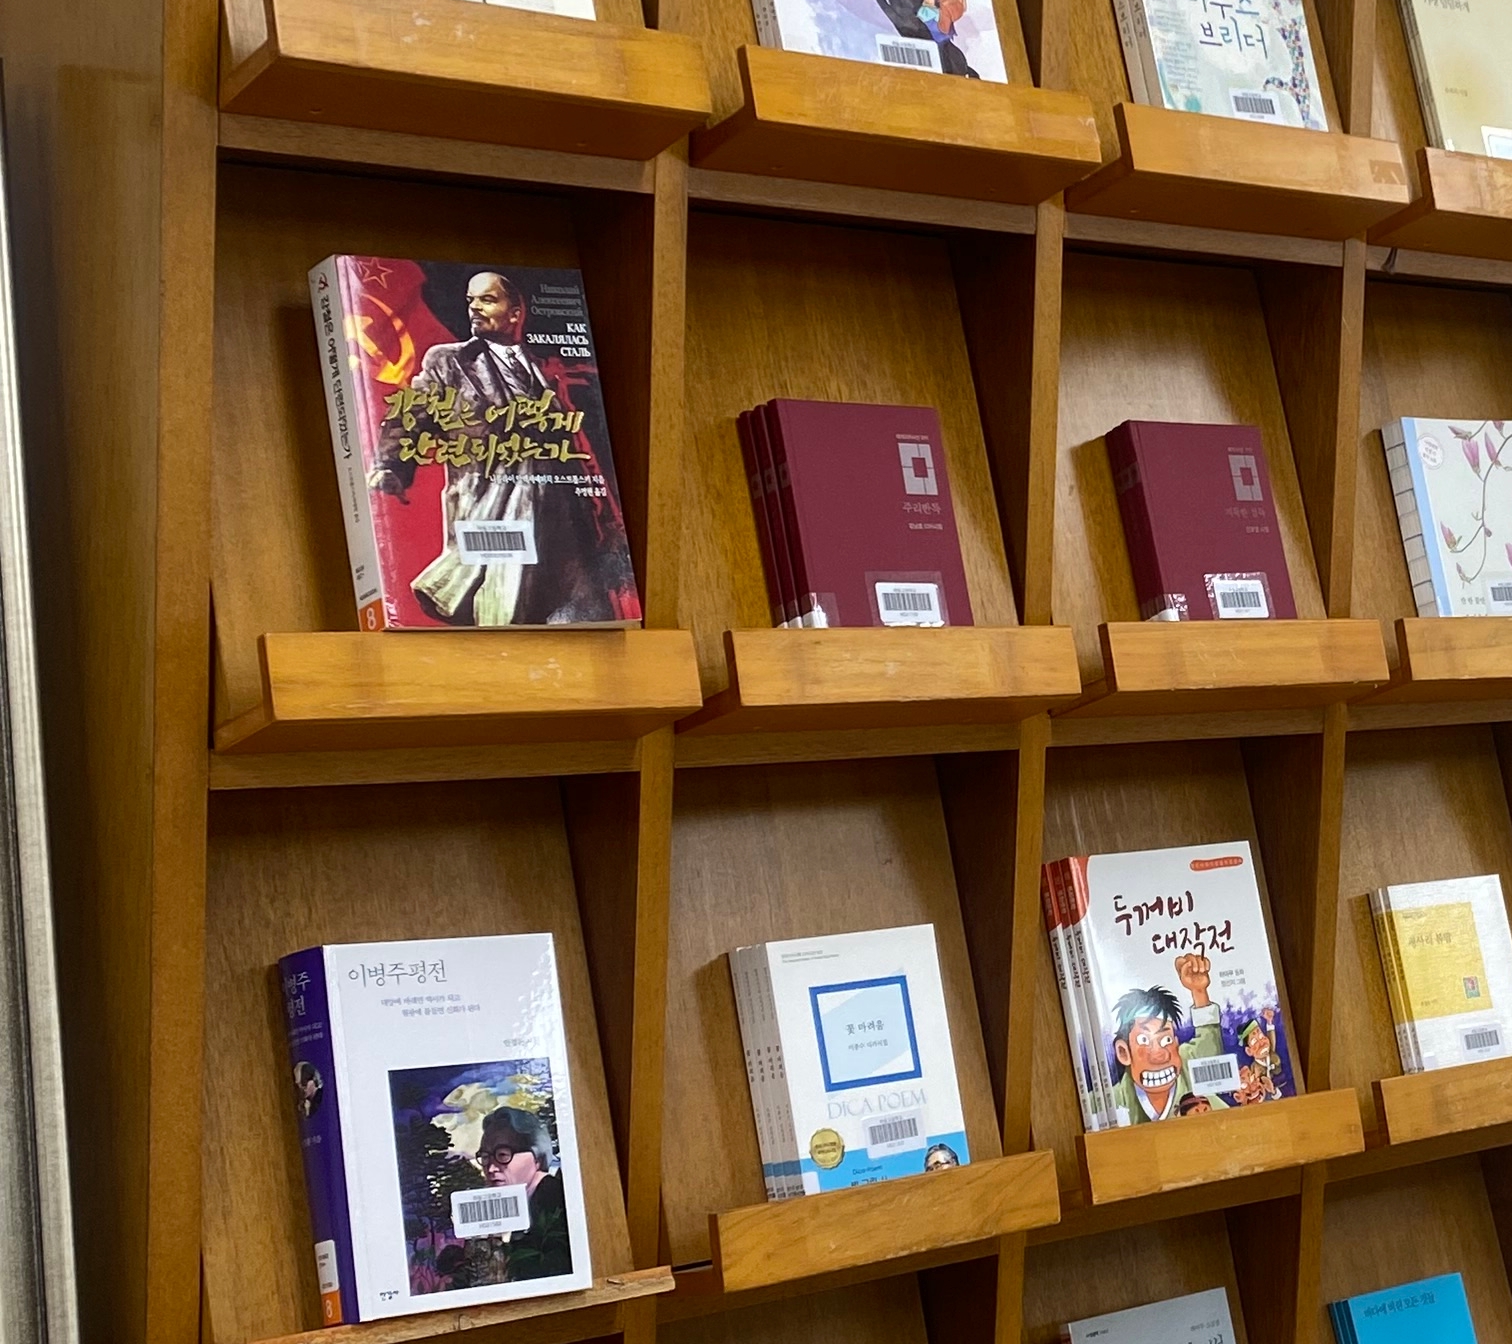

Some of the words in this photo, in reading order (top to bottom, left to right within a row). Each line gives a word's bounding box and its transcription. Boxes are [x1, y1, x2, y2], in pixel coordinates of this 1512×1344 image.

[1199, 16, 1268, 59] 브리더
[526, 333, 589, 346] ЗАКАЛЯЛАСЬ
[567, 323, 586, 334] КАК
[560, 346, 591, 358] СТАЛЬ
[383, 383, 481, 432] 강철은
[487, 389, 585, 433] 어떻게
[1113, 891, 1195, 936] 두꺼비
[1152, 919, 1235, 961] 대작전
[828, 1098, 873, 1120] DICA
[877, 1088, 928, 1111] POEM
